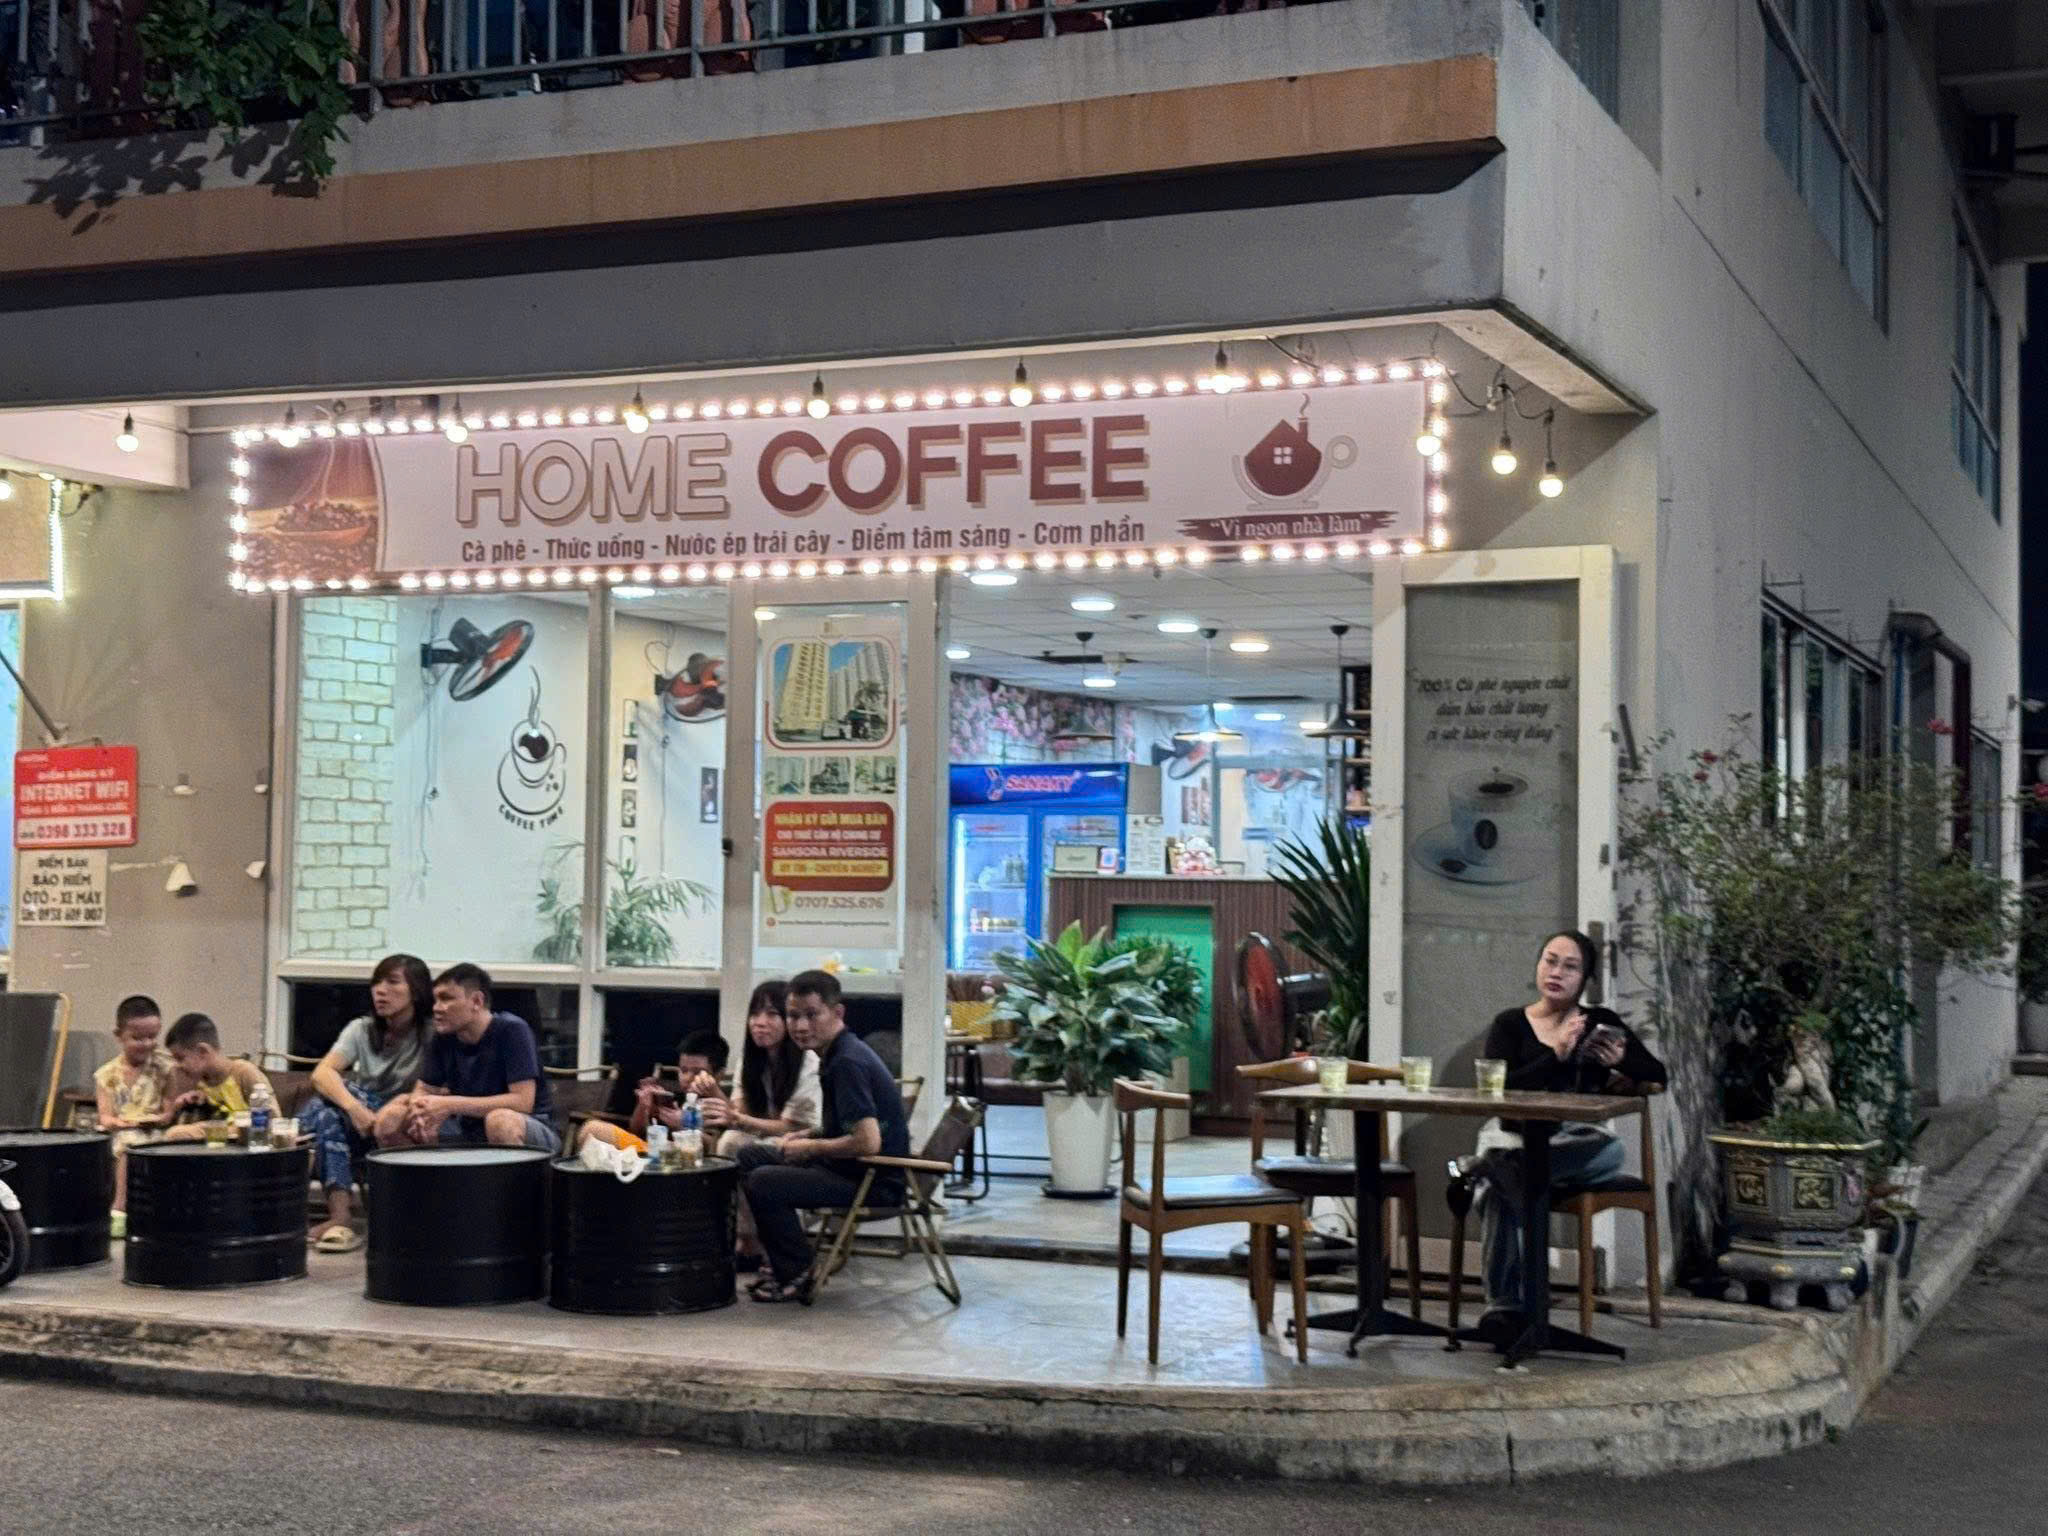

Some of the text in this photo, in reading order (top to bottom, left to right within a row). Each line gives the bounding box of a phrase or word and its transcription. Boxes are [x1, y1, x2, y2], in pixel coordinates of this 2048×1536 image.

[456, 414, 1150, 527] HOME COFFEE
[463, 540, 485, 562] Cà
[492, 540, 526, 564] phê
[546, 537, 591, 560] Thức
[598, 533, 645, 559] uống
[666, 533, 716, 556] Nước
[723, 531, 746, 556] ép
[755, 530, 787, 553] trái
[795, 529, 831, 551] cây
[852, 522, 905, 551] Điểm
[913, 526, 951, 549] tâm
[960, 523, 1010, 548] sáng
[1034, 521, 1082, 545] Cơm
[1090, 515, 1144, 546] phần
[1244, 522, 1288, 540] ngon
[1292, 516, 1323, 535] nhà
[20, 780, 129, 802] INTERNET WIFI
[499, 804, 535, 831] COFFEE
[829, 846, 889, 857] RIVERSIDE
